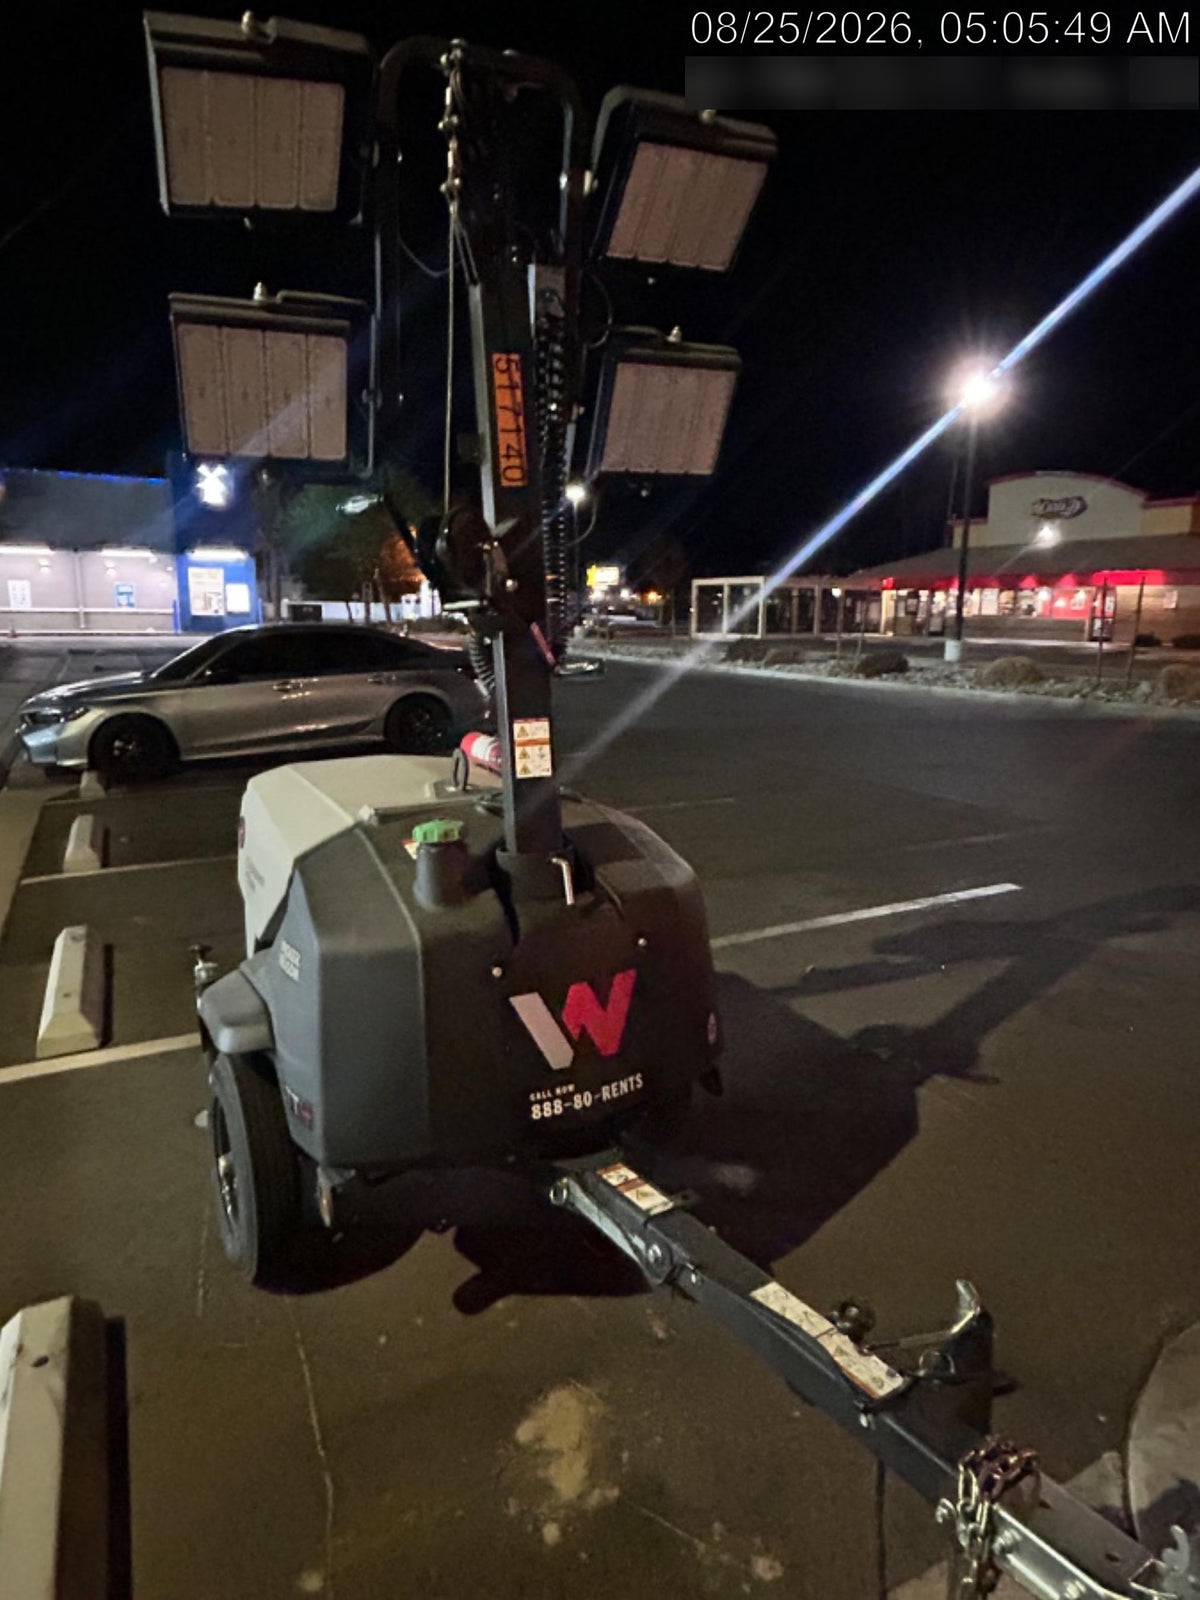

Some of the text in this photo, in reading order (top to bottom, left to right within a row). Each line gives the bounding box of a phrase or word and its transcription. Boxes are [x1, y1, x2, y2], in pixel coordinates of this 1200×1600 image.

[495, 355, 525, 483] 517140
[530, 1083, 576, 1102] CALL NOW
[532, 1073, 644, 1120] 888-80-RENTS
